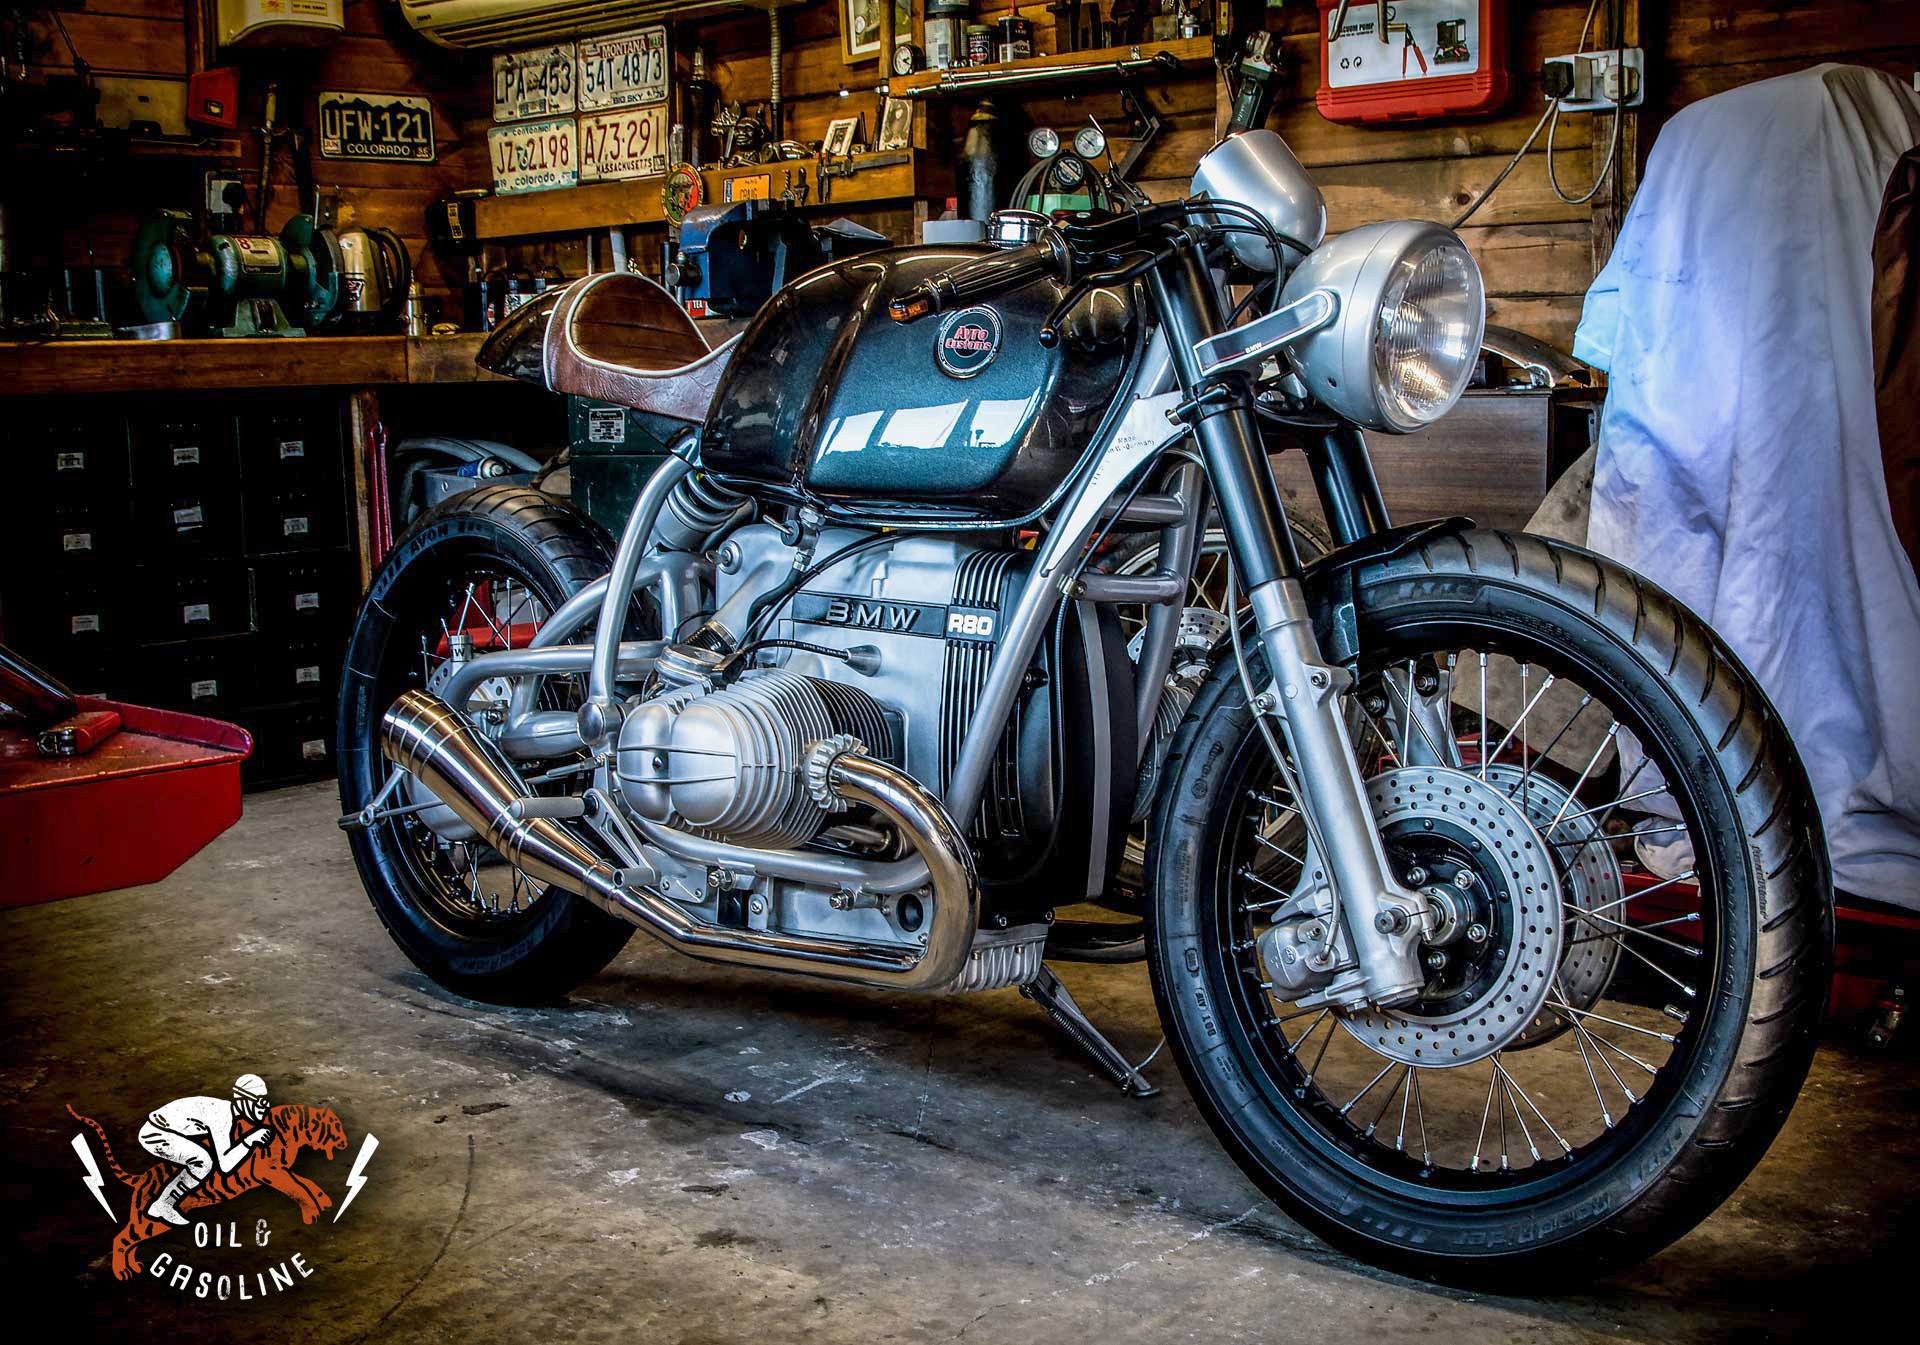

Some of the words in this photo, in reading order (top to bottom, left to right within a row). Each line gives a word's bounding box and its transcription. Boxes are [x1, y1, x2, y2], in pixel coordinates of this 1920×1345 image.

[601, 39, 647, 58] MONTANA
[627, 93, 643, 103] SKY
[347, 143, 411, 156] COLORADO
[596, 159, 653, 174] MASSACHUSETTS
[515, 172, 556, 187] colorado
[692, 300, 704, 309] TEA
[1245, 342, 1263, 355] BMW
[410, 525, 450, 557] AVON
[826, 600, 920, 632] BMW
[949, 612, 994, 636] R80
